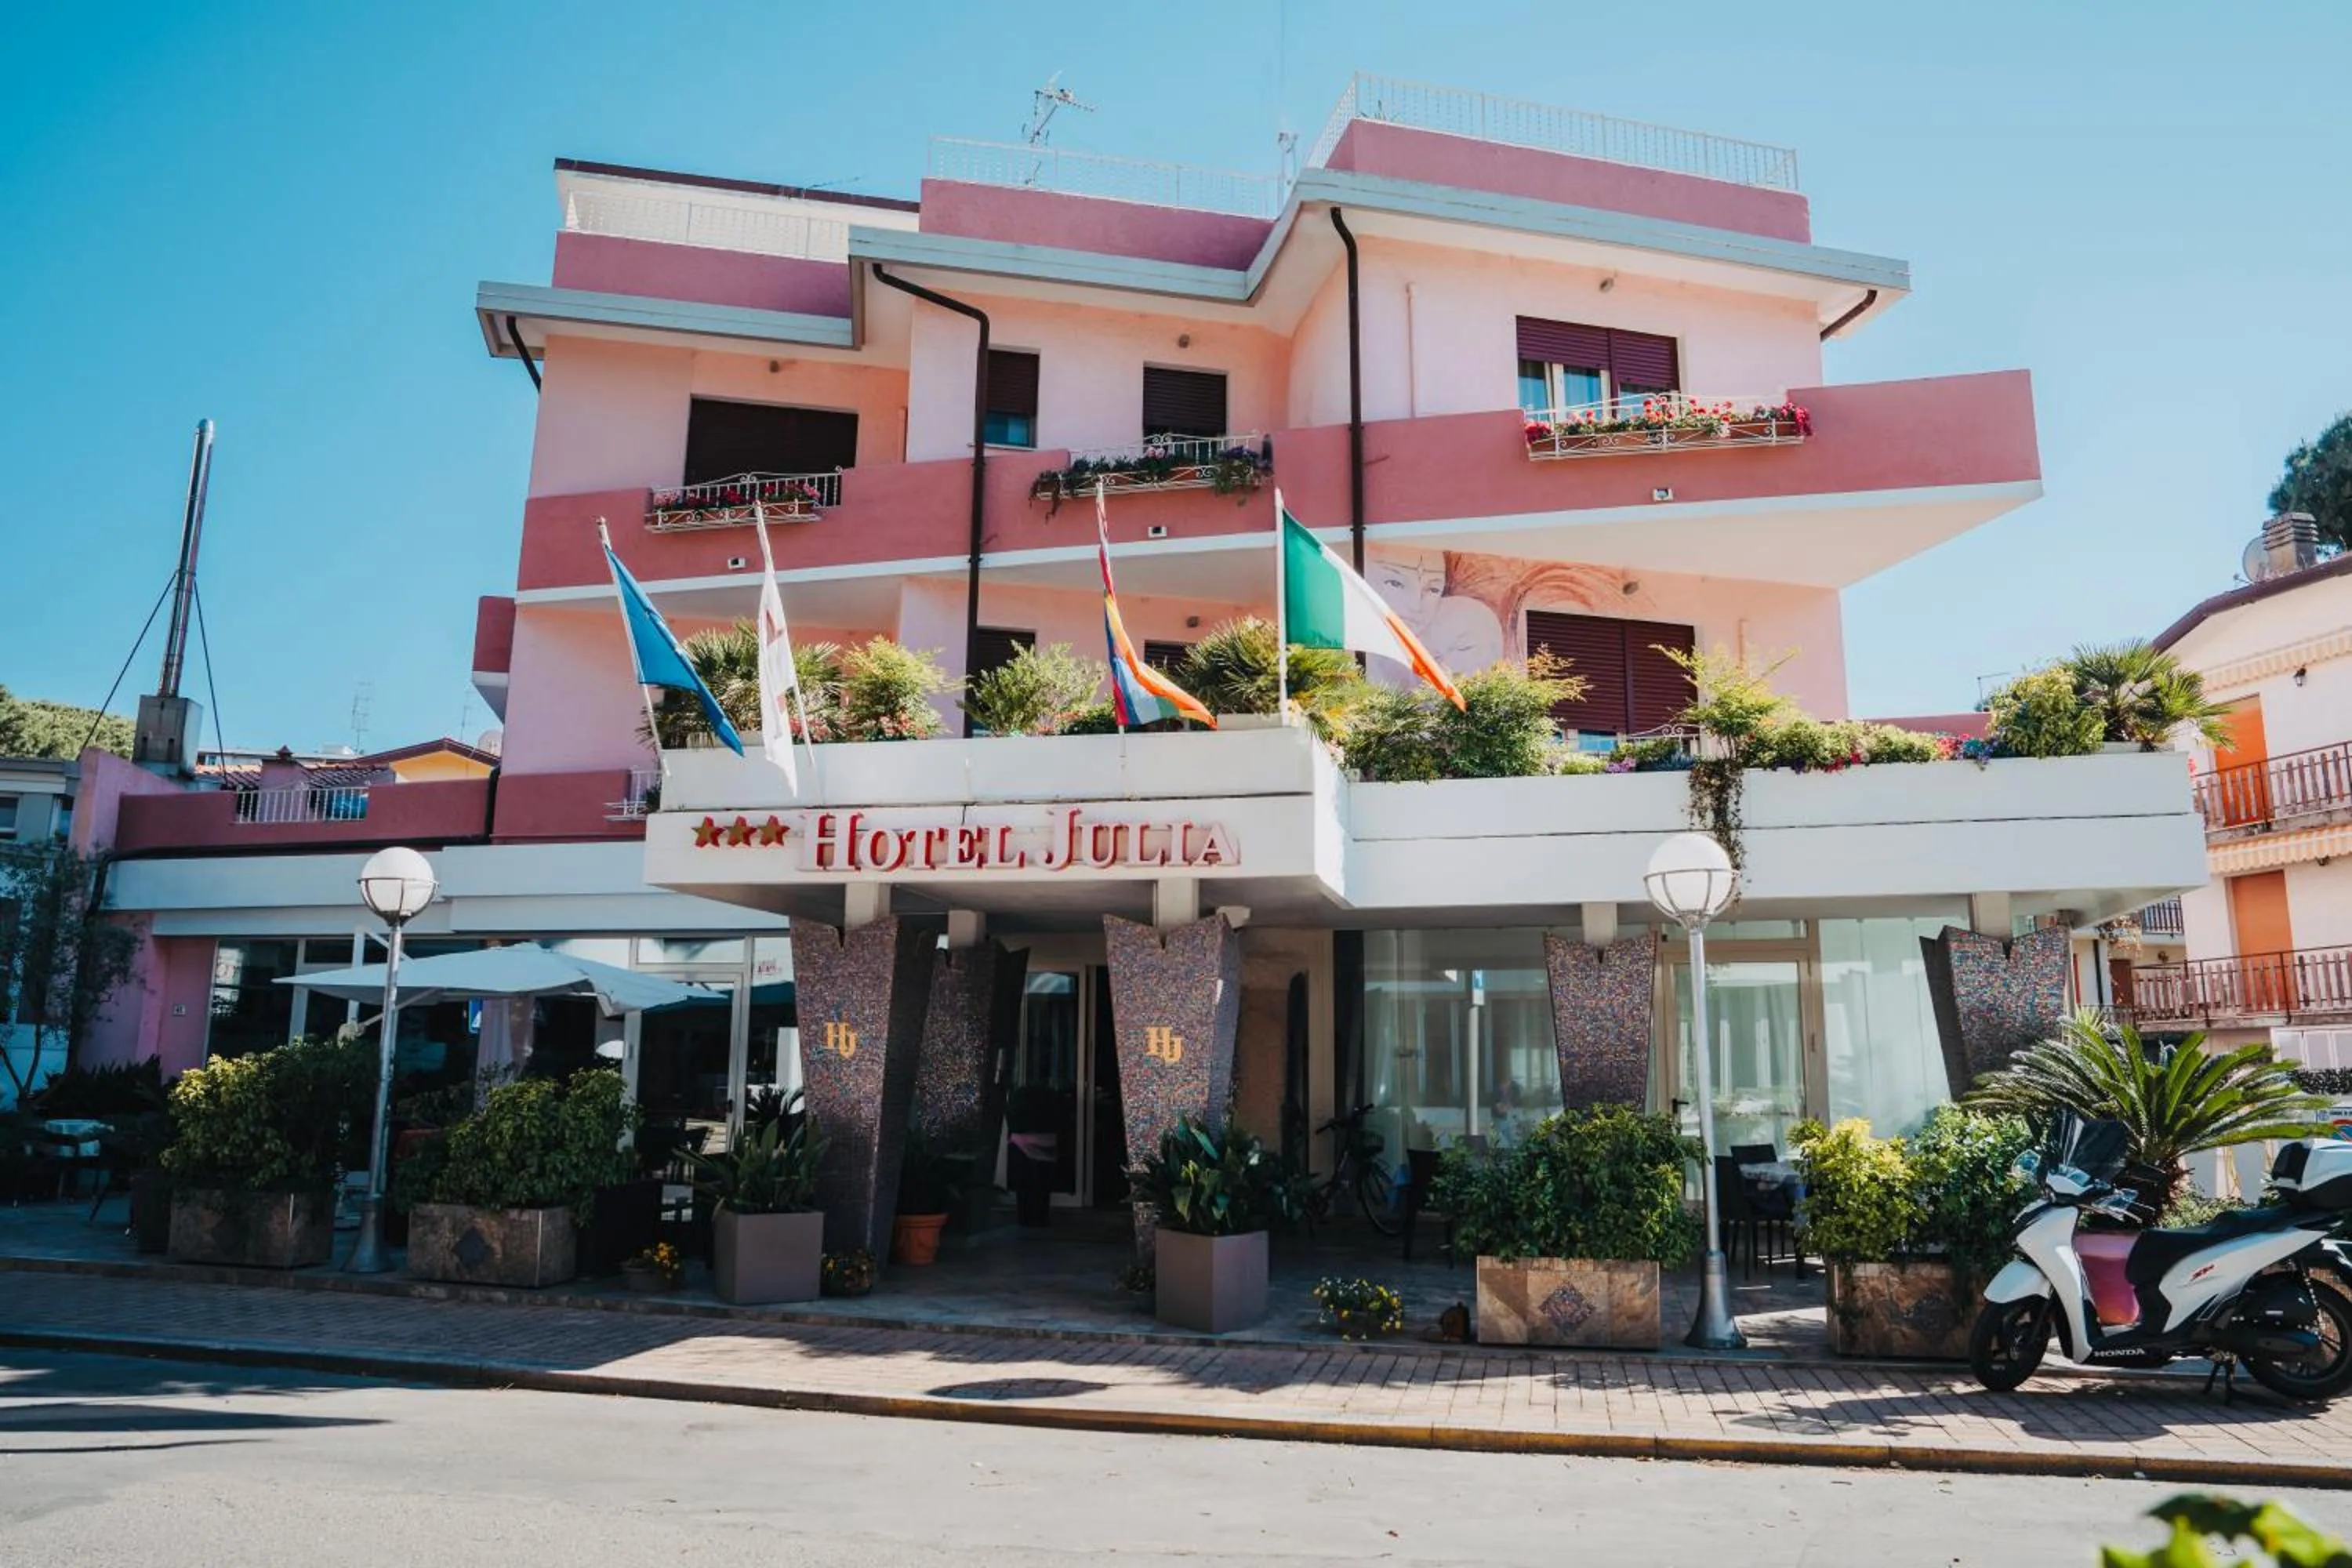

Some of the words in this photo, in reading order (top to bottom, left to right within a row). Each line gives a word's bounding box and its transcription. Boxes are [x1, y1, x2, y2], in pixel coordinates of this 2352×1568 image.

[799, 811, 1025, 872] HOTEL
[1037, 807, 1240, 872] JULIA
[2093, 1348, 2146, 1357] HONDA
